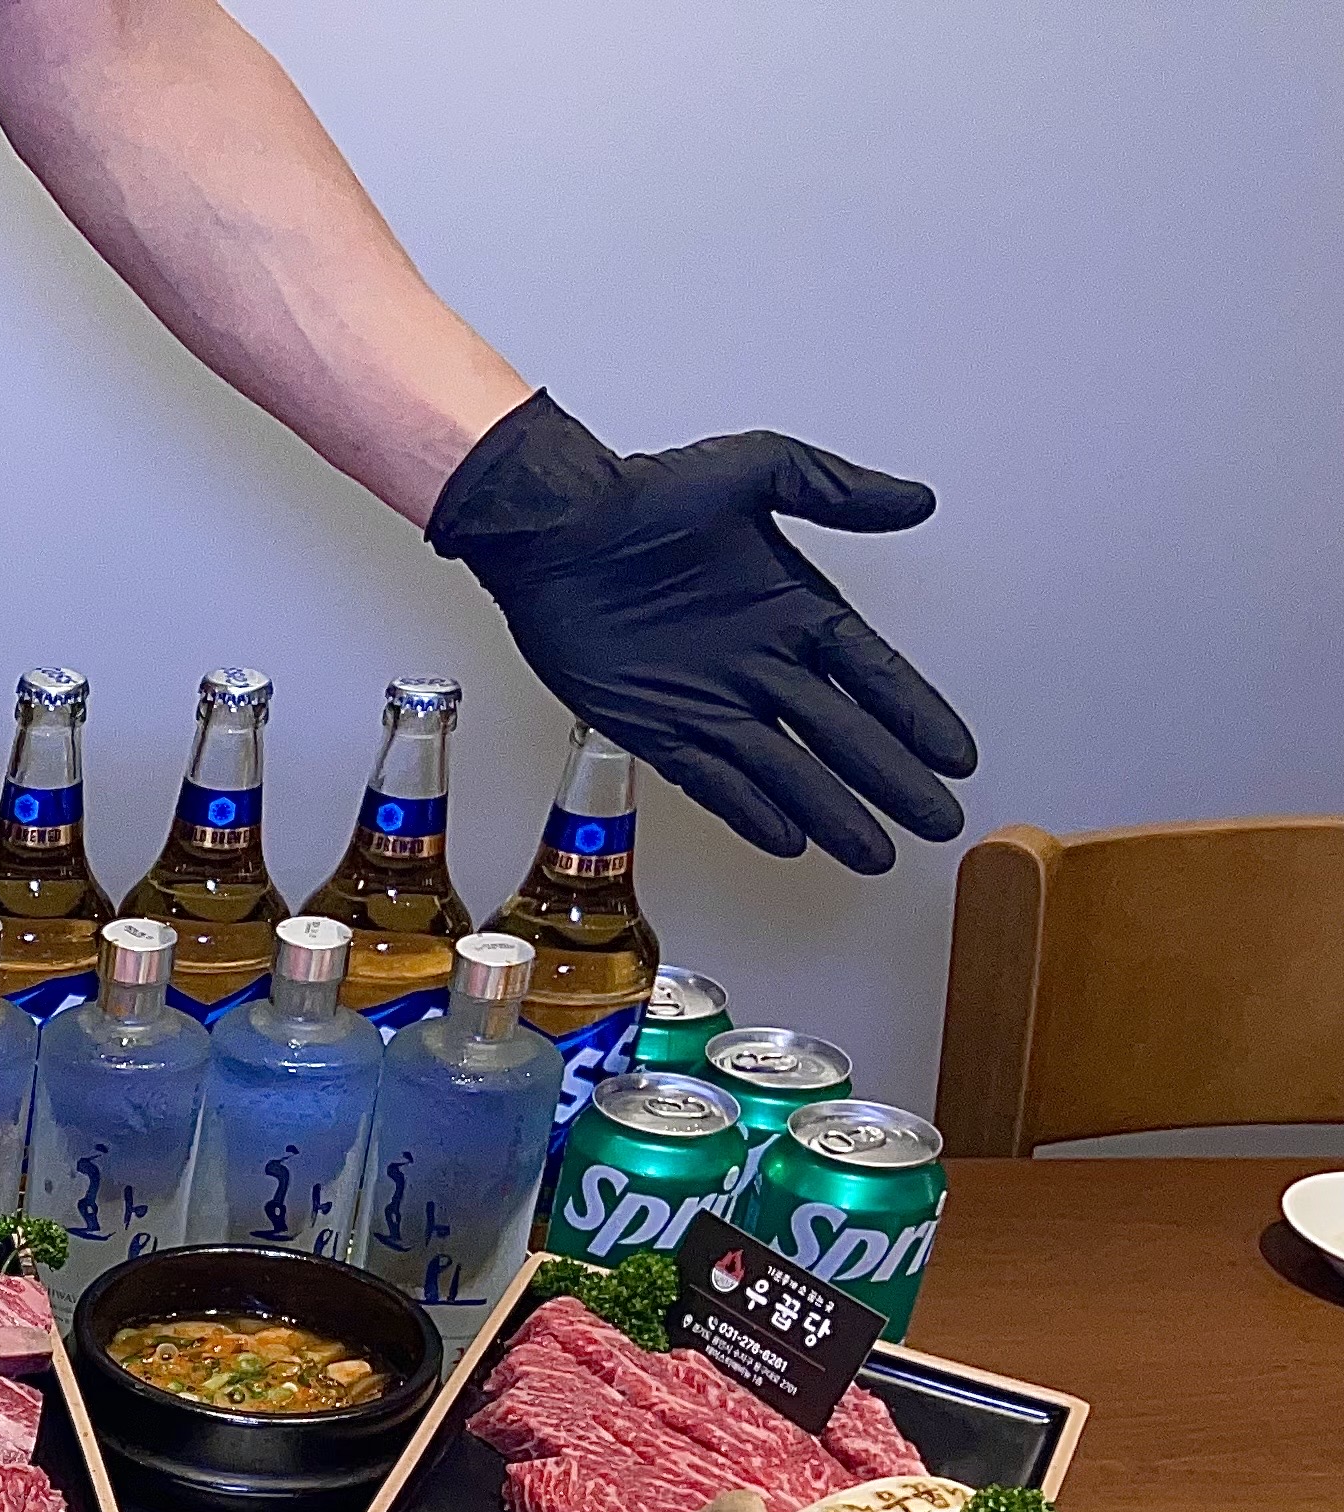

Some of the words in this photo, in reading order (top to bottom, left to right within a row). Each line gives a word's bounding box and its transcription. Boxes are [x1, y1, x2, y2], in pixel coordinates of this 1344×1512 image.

[563, 1163, 740, 1258] Spri
[768, 1190, 948, 1283] Spri
[745, 1279, 831, 1347] 우꿉당
